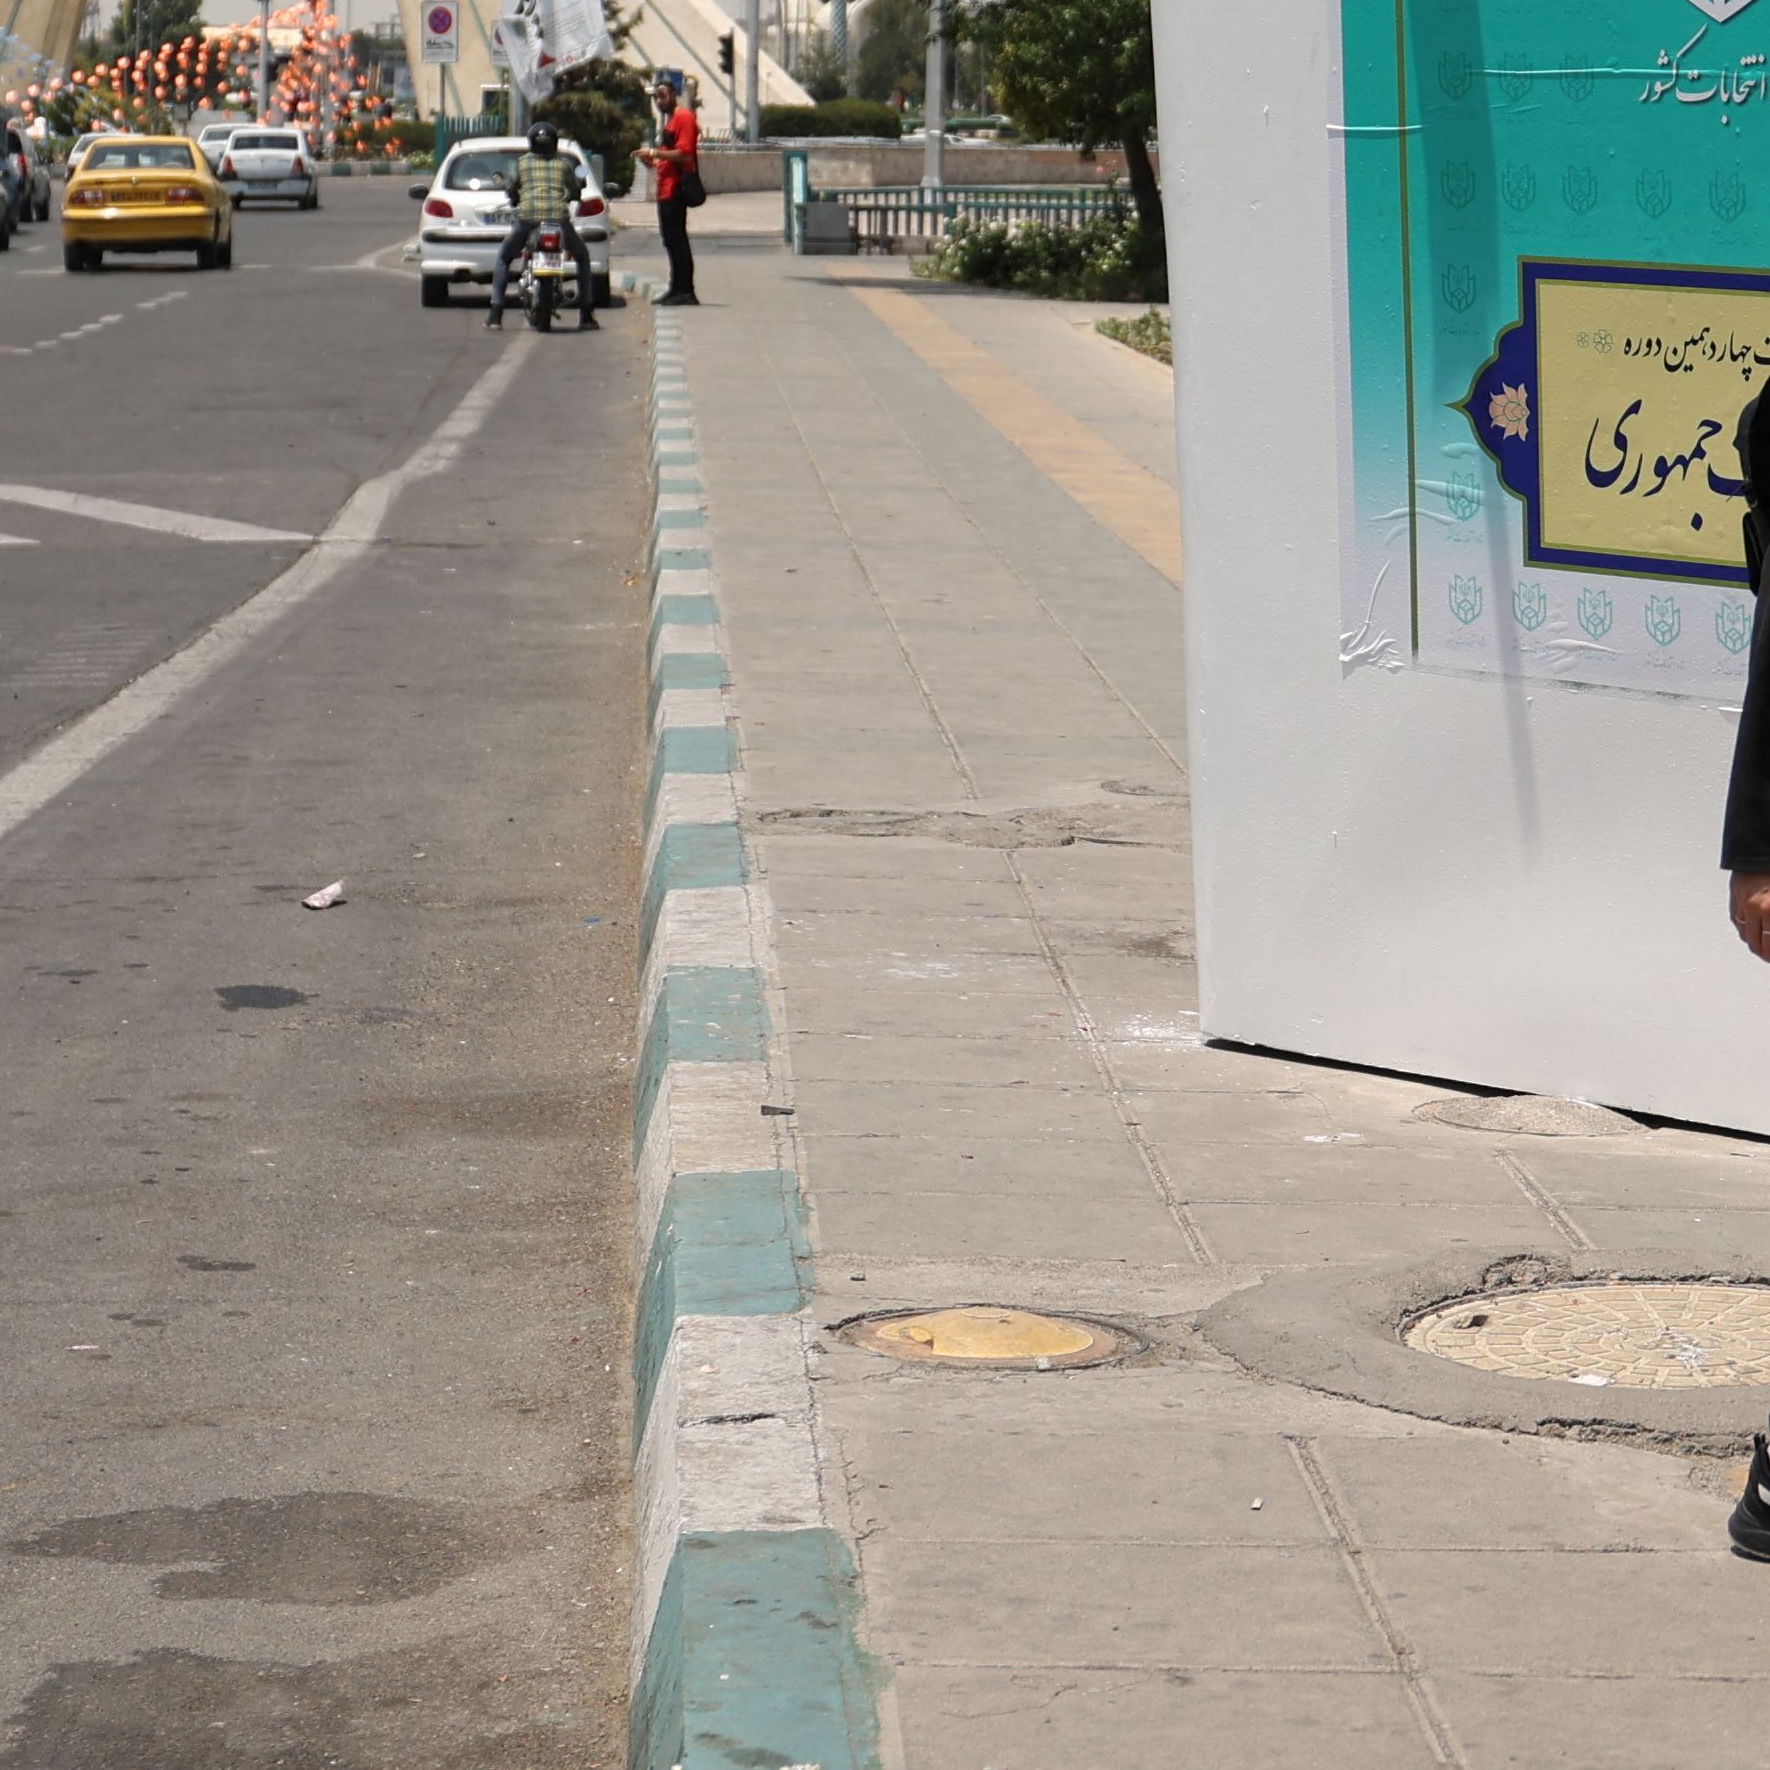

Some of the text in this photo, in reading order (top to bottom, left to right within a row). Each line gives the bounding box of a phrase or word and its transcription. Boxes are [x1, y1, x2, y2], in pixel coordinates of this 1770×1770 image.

[1638, 23, 1707, 102] کشور
[1675, 54, 1766, 124] انتخابات
[1623, 337, 1663, 357] دوره
[1664, 326, 1752, 382] چهاردهمین
[1585, 399, 1723, 531] جمهوری
